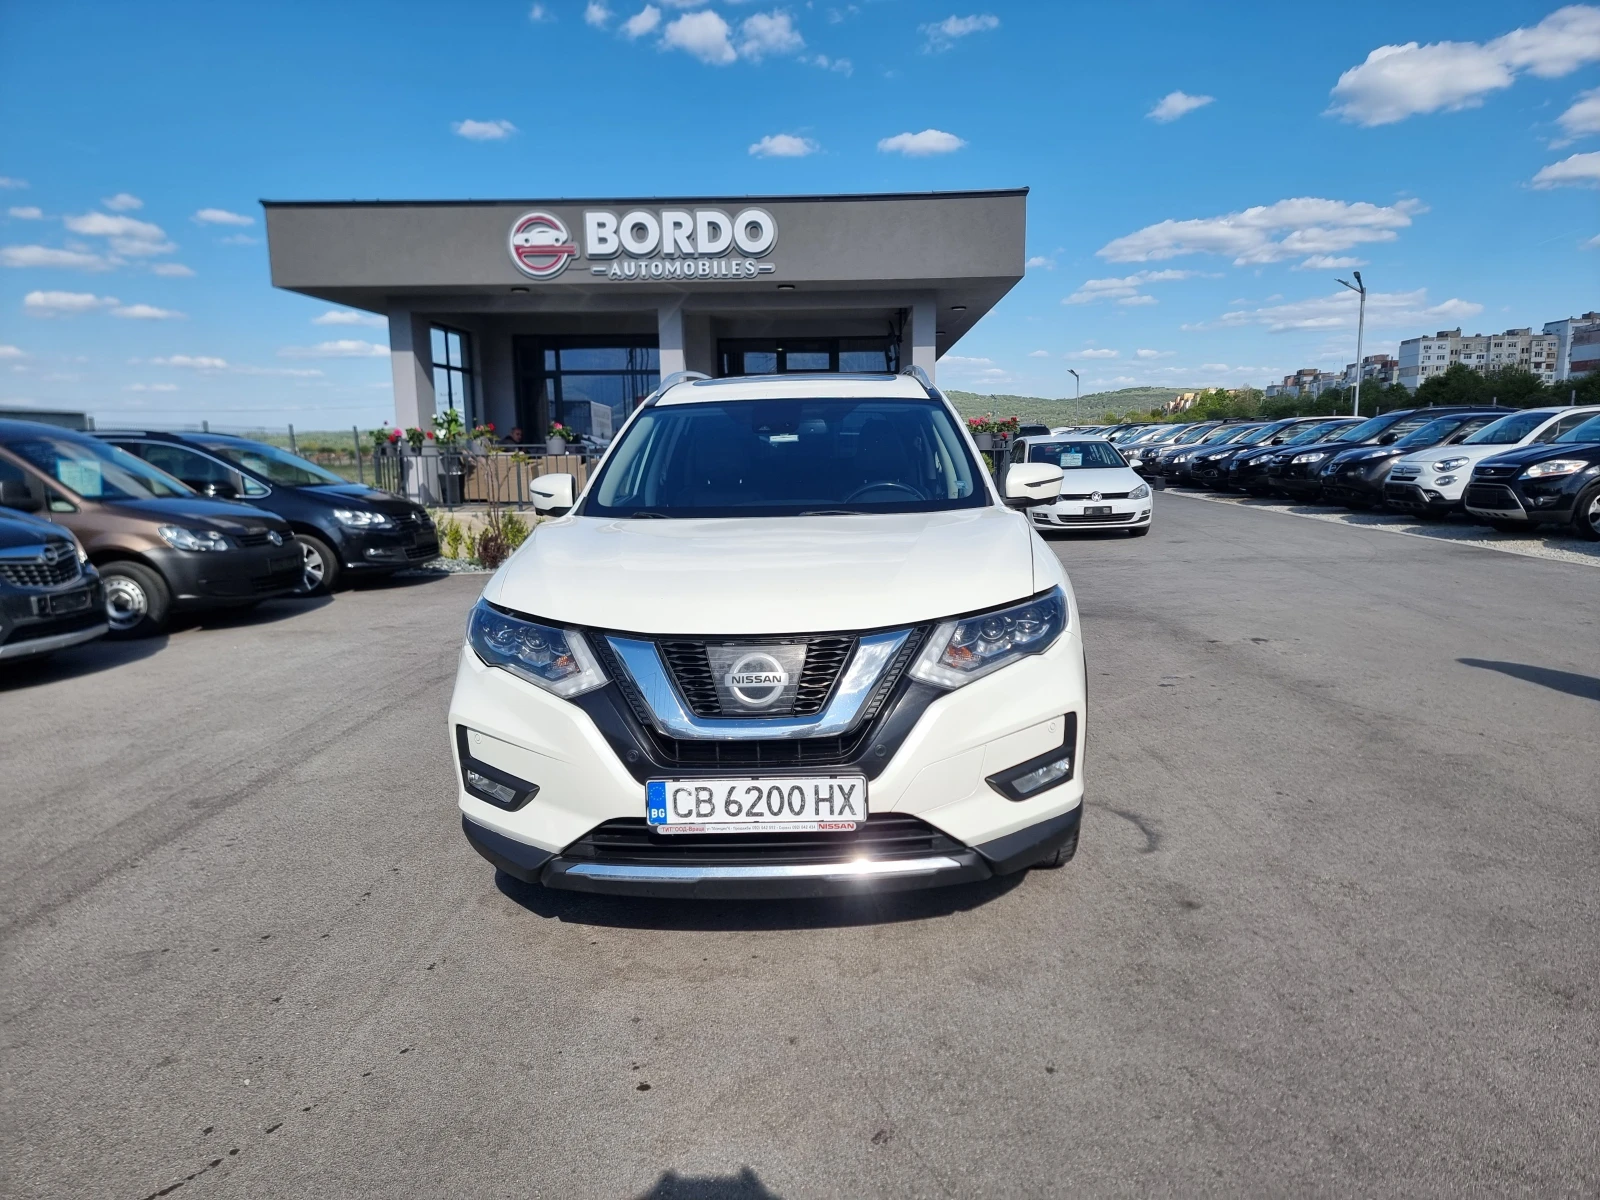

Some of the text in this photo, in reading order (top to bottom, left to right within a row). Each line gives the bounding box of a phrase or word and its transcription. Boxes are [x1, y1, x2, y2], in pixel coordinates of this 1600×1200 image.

[585, 209, 776, 256] BORDO
[609, 260, 757, 279] AUTOMOBILES
[731, 675, 782, 684] NISSAN
[672, 784, 857, 818] CB 6200 HX
[651, 808, 666, 818] BG
